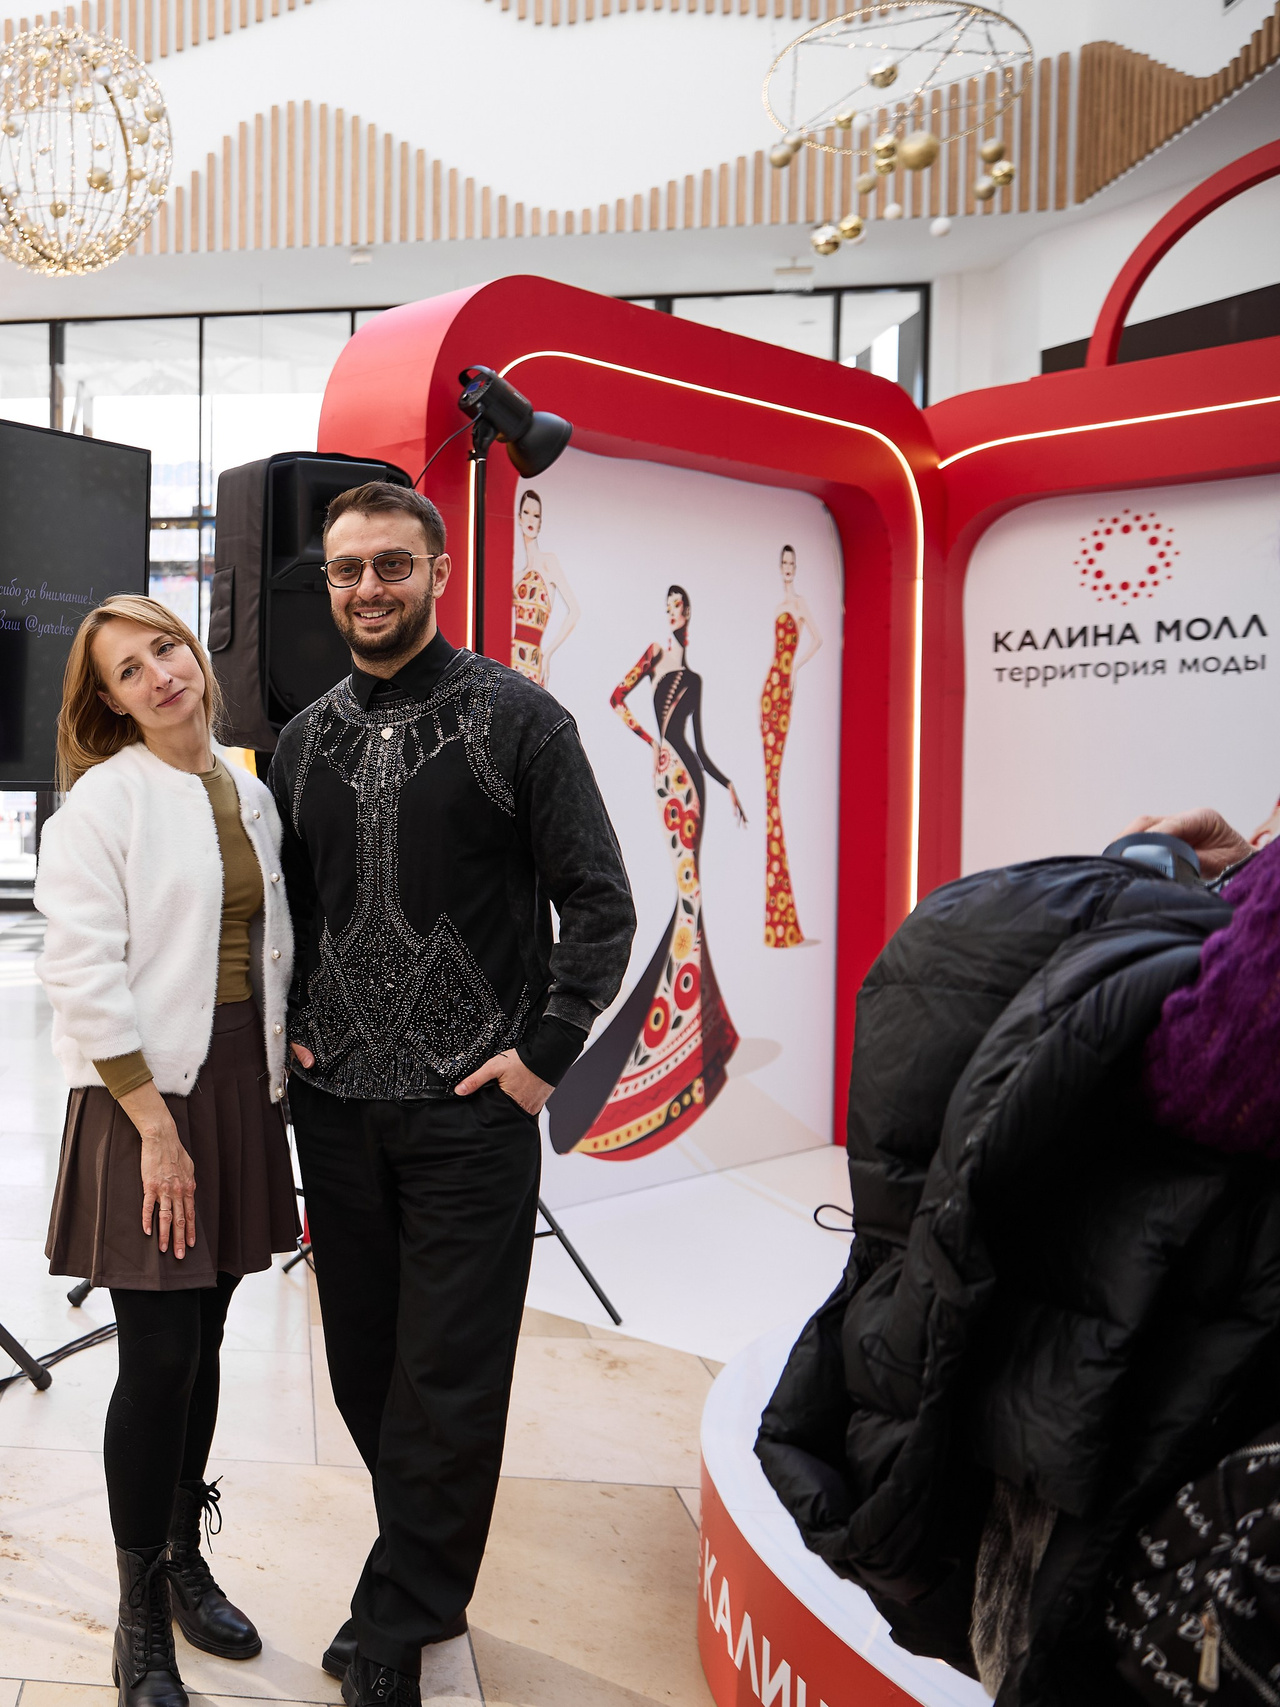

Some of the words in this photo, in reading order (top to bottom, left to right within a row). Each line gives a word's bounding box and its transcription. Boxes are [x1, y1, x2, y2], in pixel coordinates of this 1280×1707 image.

[21, 588, 36, 606] за
[40, 581, 94, 605] внимание!
[993, 622, 1140, 653] КАЛИНА
[1155, 613, 1268, 643] МОЛЛ
[994, 658, 1167, 689] территория
[1178, 653, 1267, 676] моды
